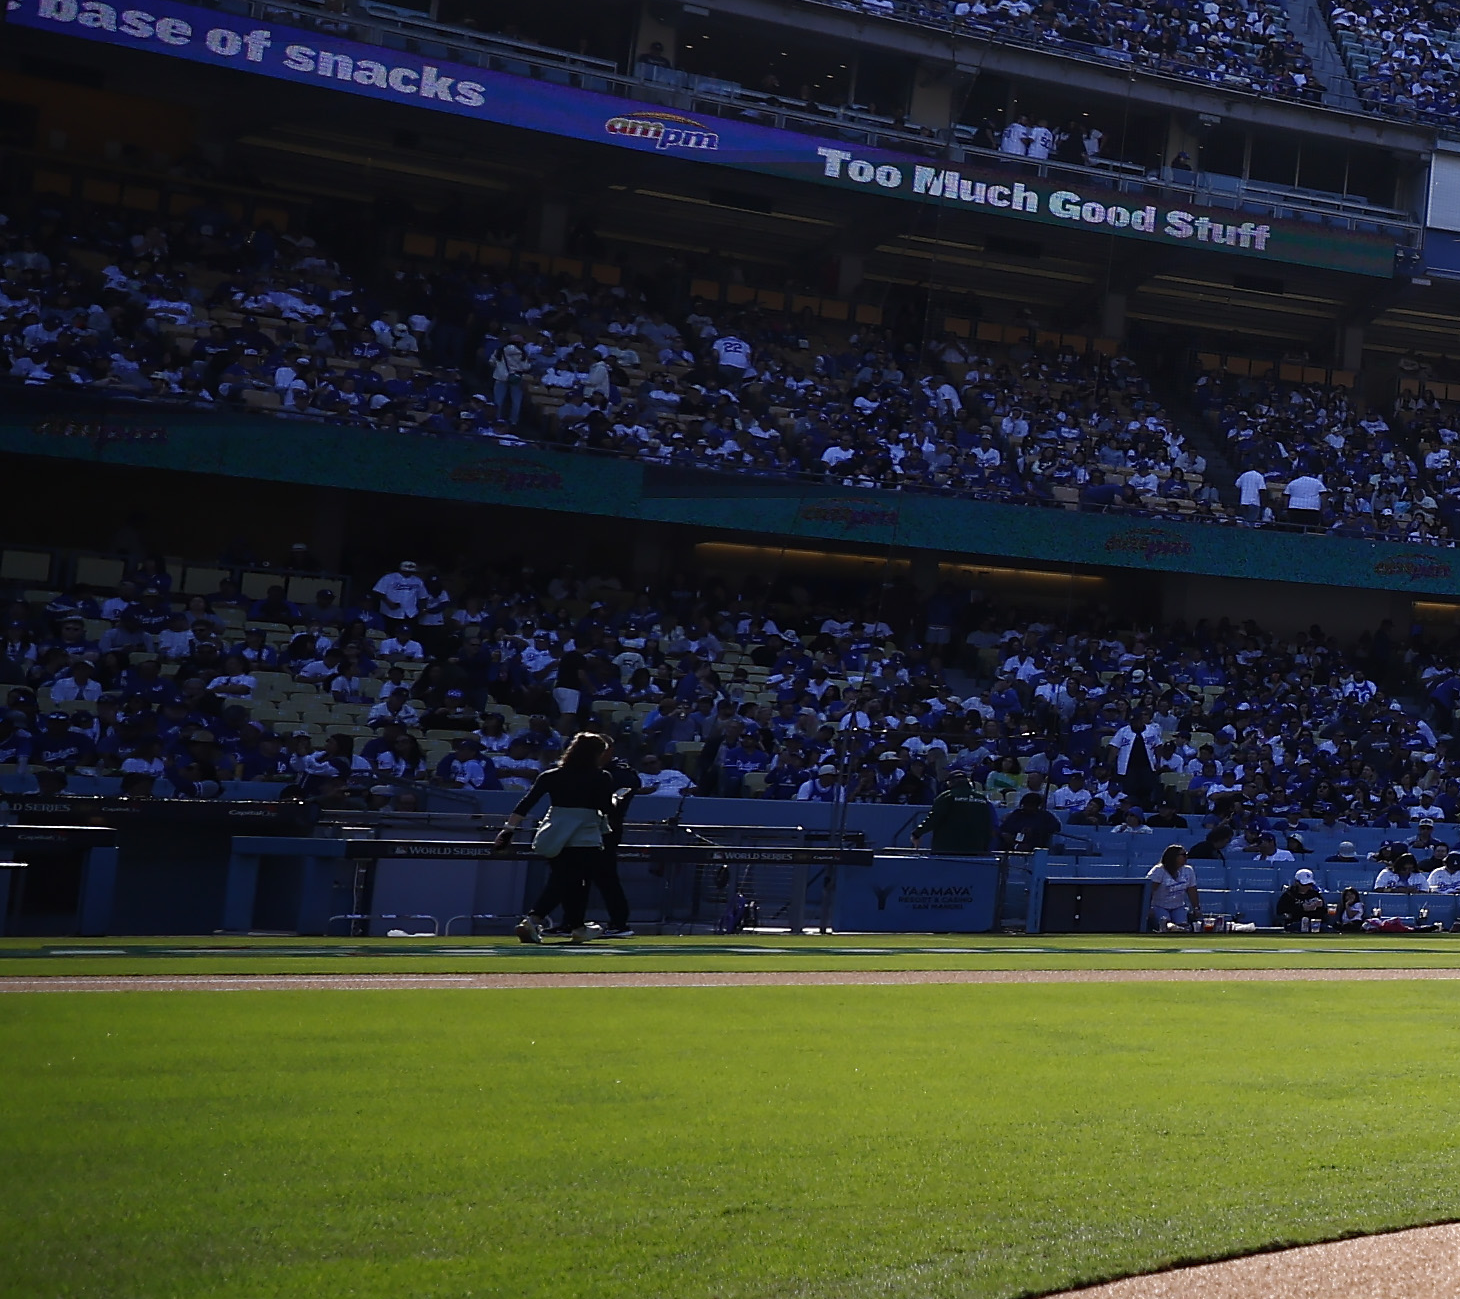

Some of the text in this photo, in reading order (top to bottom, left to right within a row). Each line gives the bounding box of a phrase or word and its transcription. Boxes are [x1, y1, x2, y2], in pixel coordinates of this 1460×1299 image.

[205, 28, 272, 63] of
[283, 44, 486, 107] snacks
[605, 117, 720, 150] ampm
[817, 146, 1272, 252] Too Much Good Stuff
[723, 342, 743, 353] 22
[408, 846, 493, 857] WORLD SERIES
[724, 851, 794, 862] WORLD SERIES
